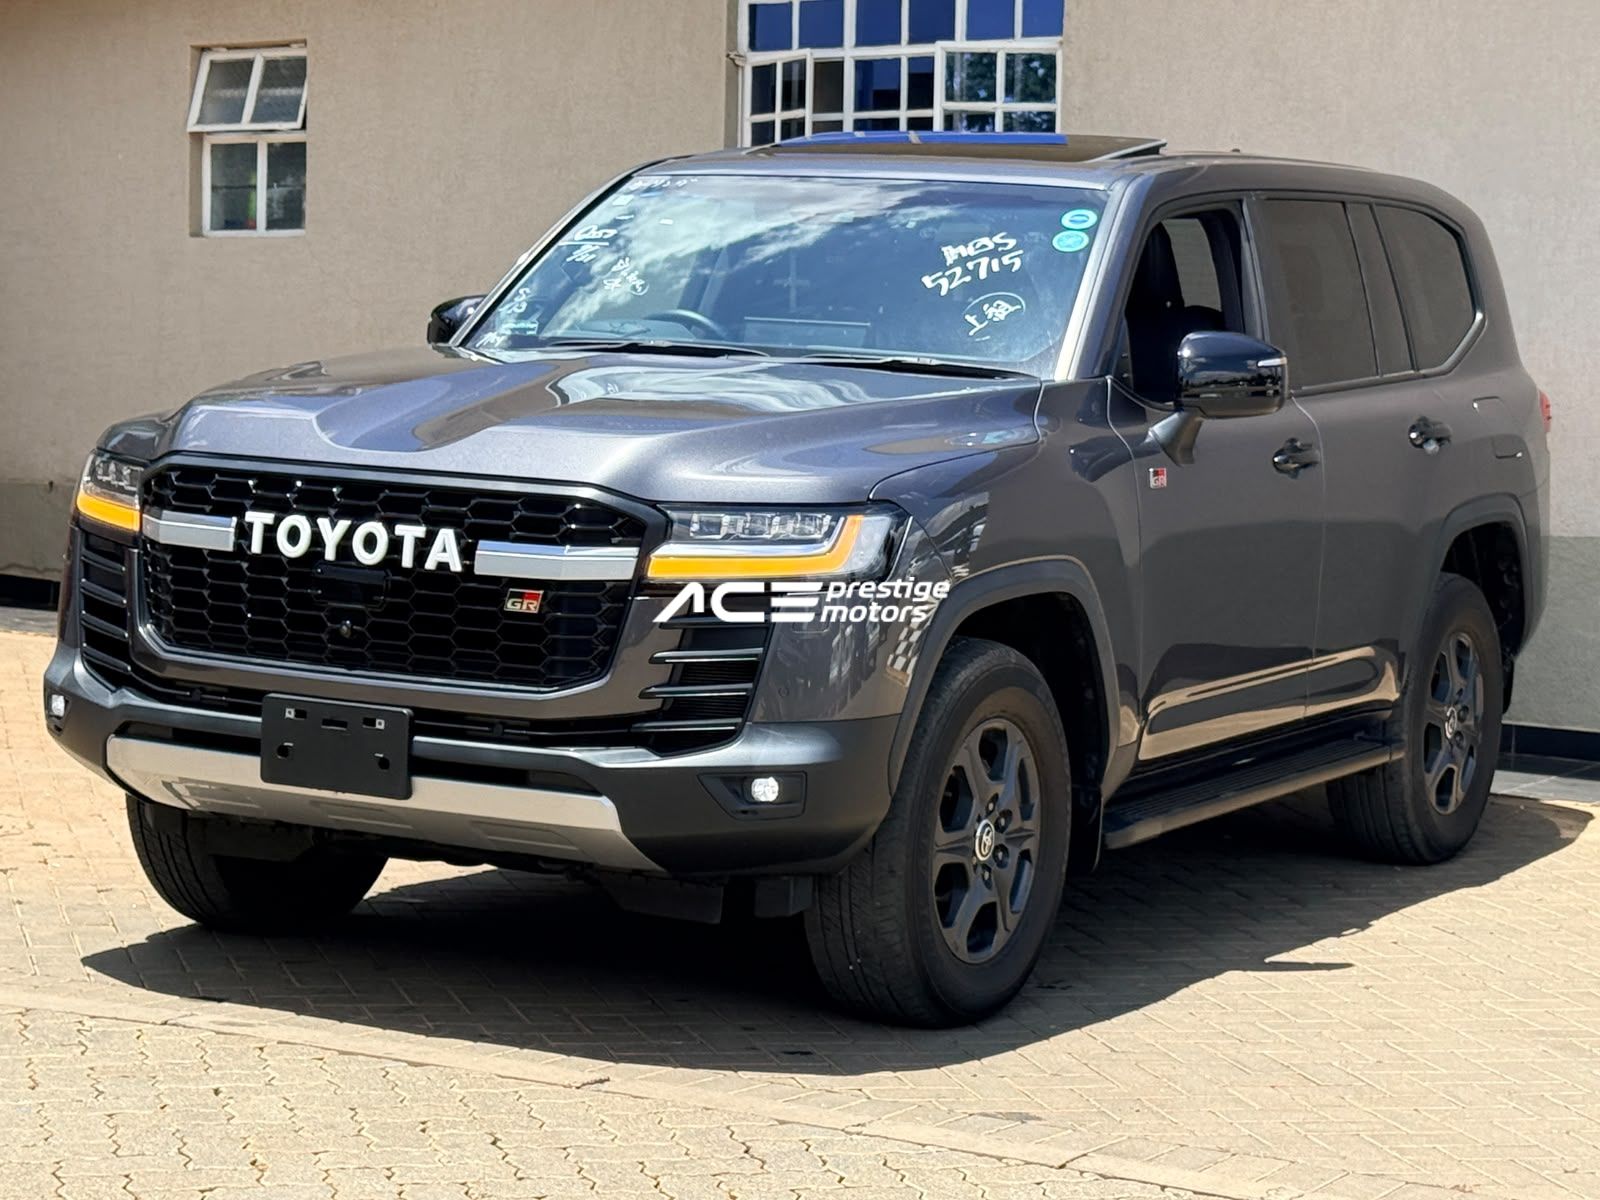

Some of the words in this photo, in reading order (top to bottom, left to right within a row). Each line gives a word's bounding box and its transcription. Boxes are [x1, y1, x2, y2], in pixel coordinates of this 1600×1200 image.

[921, 250, 1024, 296] 52715
[244, 511, 463, 572] TOYOTA
[505, 597, 540, 613] GR
